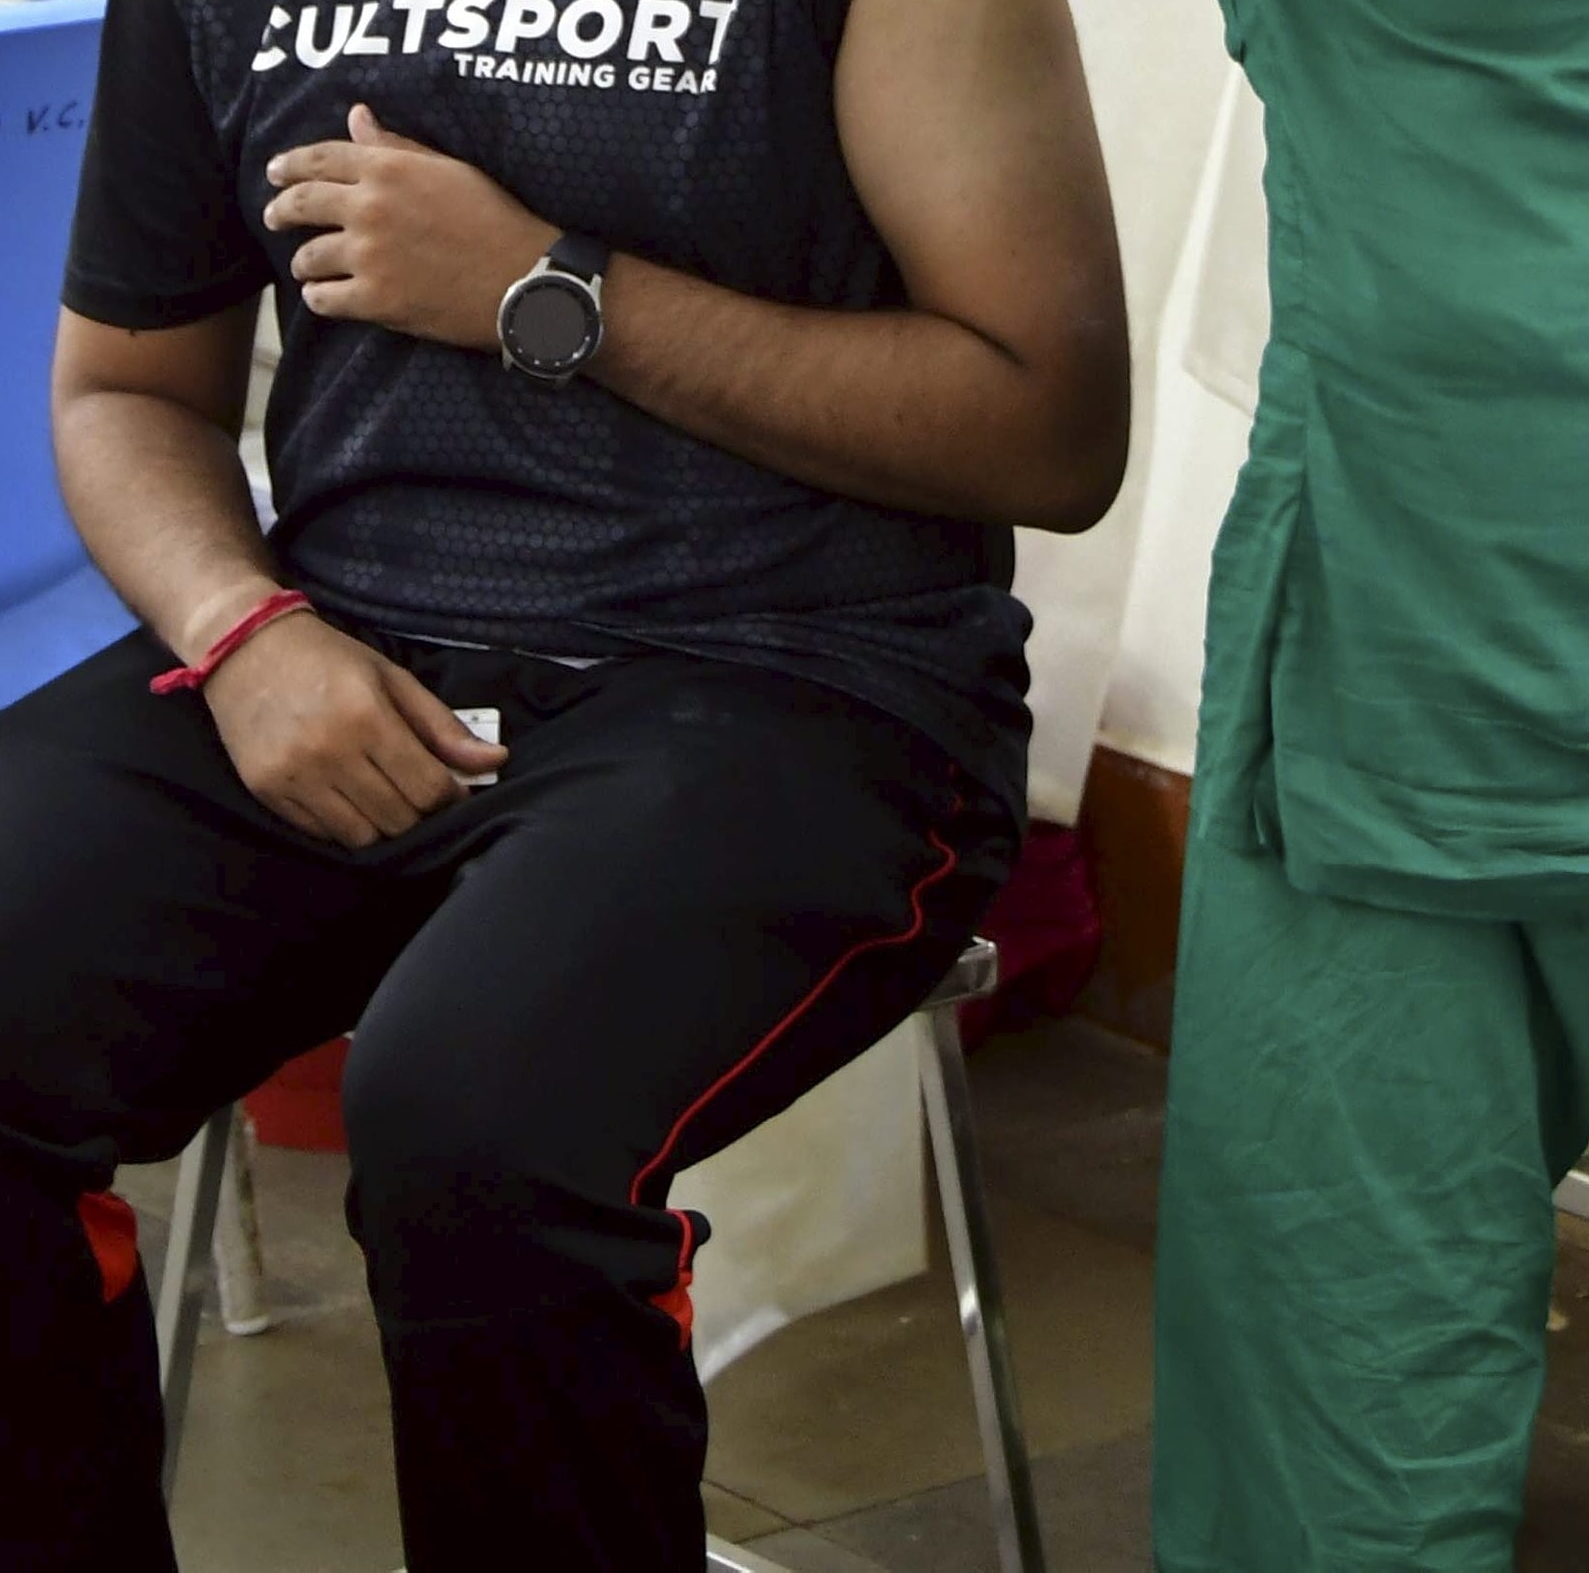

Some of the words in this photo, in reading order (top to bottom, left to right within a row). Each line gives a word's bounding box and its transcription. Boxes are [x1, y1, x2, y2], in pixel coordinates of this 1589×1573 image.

[454, 53, 616, 90] TRAINING
[627, 66, 717, 95] GEAR
[26, 101, 85, 135] V.C.
